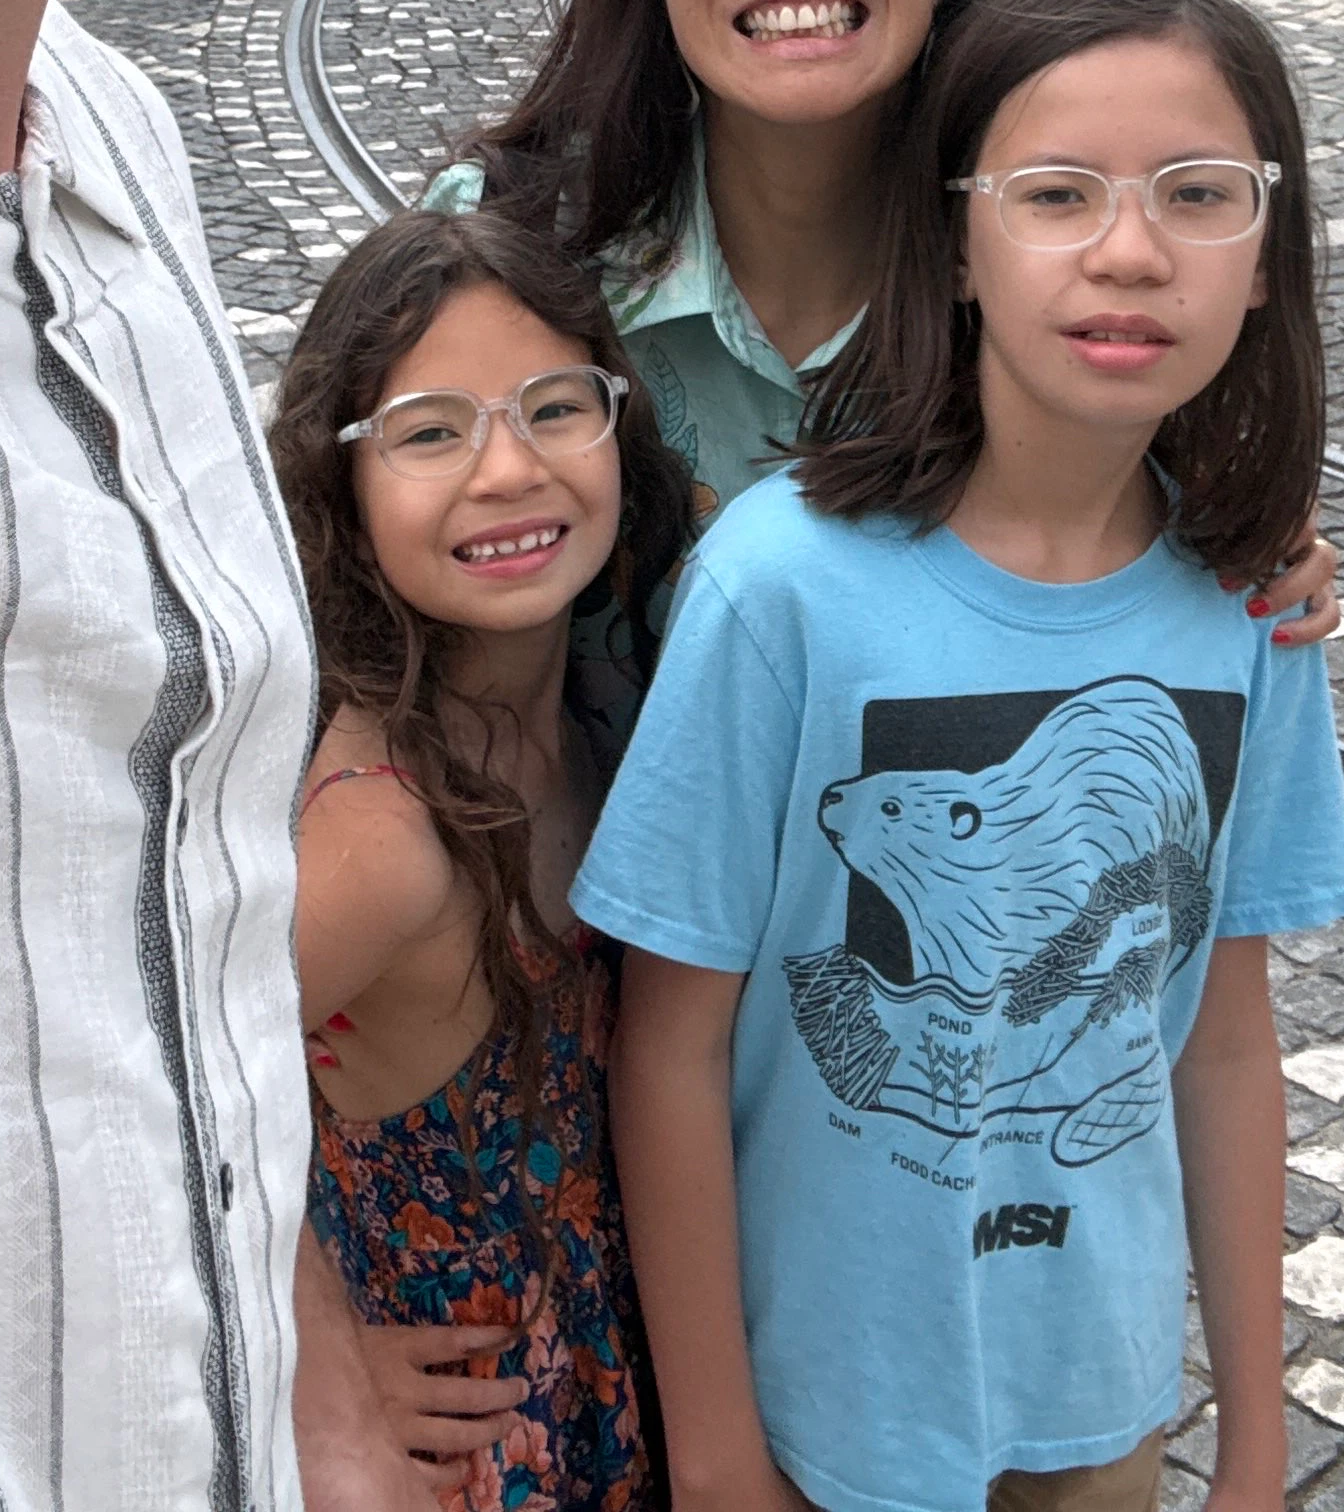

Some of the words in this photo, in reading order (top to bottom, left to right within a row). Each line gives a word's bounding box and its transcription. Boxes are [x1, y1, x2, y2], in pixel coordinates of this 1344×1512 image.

[928, 1012, 972, 1036] POND
[828, 1111, 862, 1139] DAM
[979, 1129, 1045, 1155] NTRANCE
[890, 1151, 929, 1181] FOOD
[931, 1169, 976, 1192] CACH
[973, 1202, 1071, 1261] MSI
